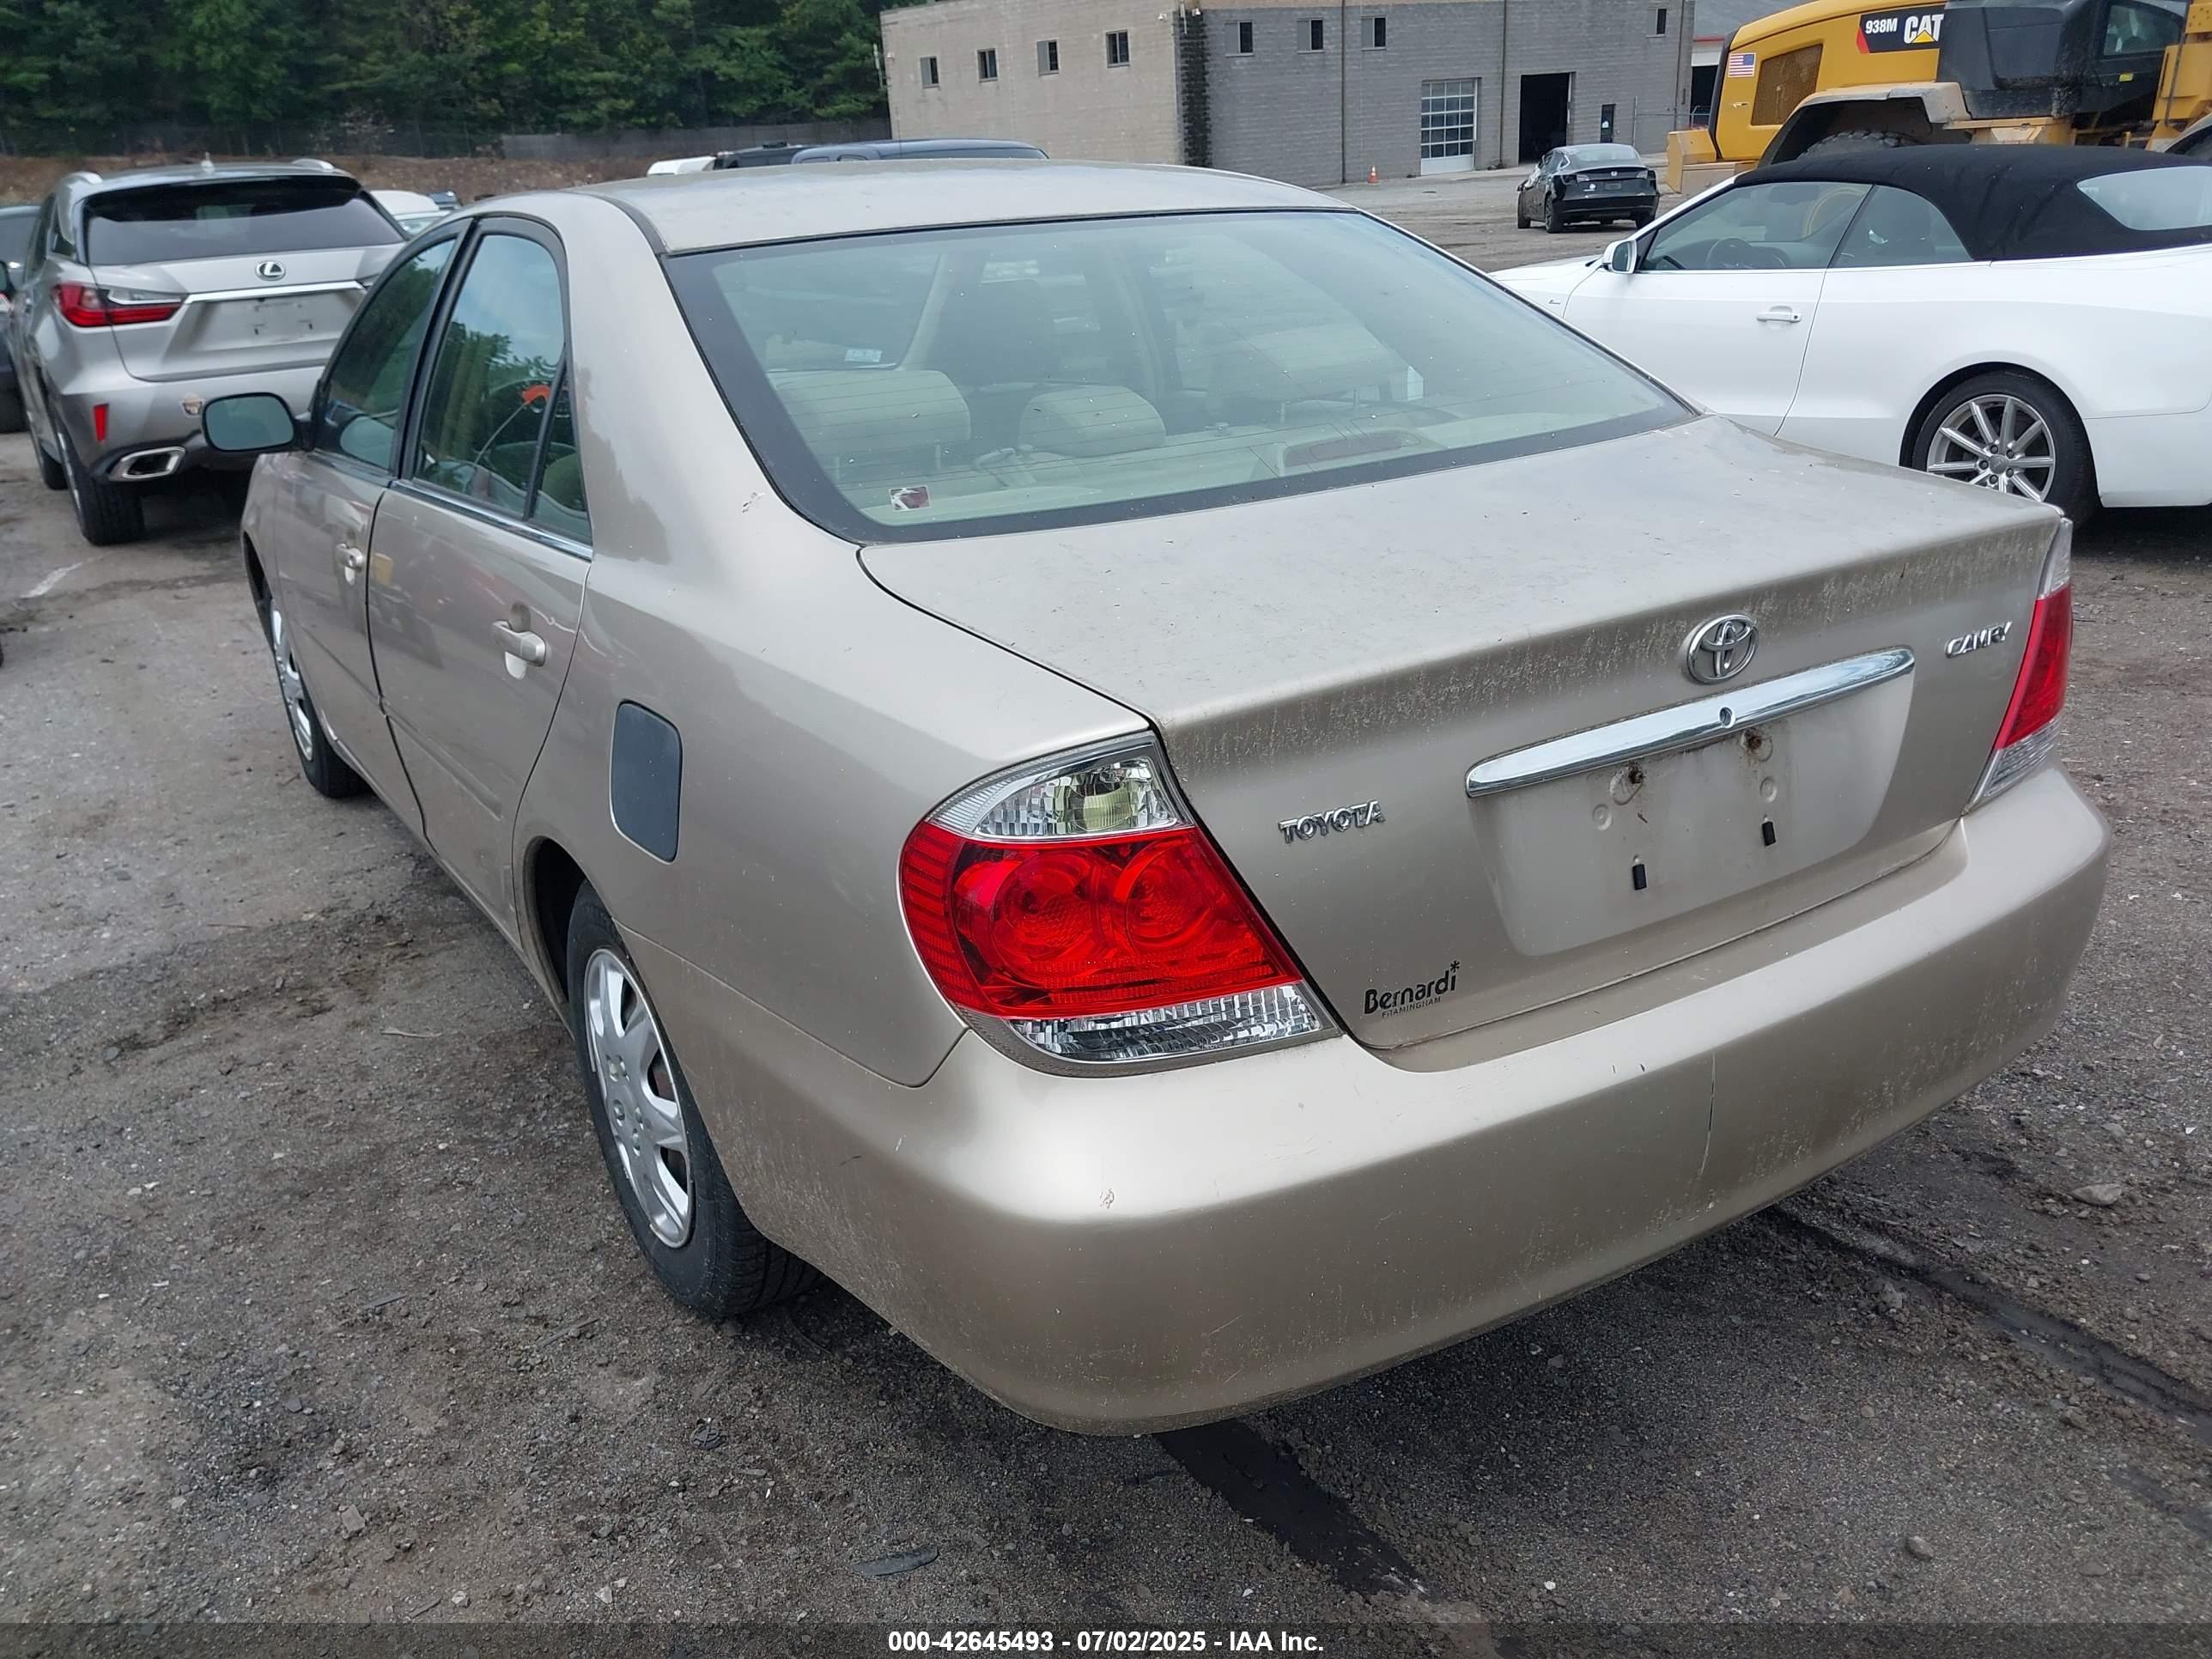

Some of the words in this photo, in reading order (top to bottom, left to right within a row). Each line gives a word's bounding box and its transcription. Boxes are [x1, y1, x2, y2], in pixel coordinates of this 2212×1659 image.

[1865, 17, 1898, 34] 938M
[1904, 14, 1945, 44] CAT
[1278, 799, 1385, 844] TOYOTA
[1381, 996, 1441, 1018] FRAMINGHAM
